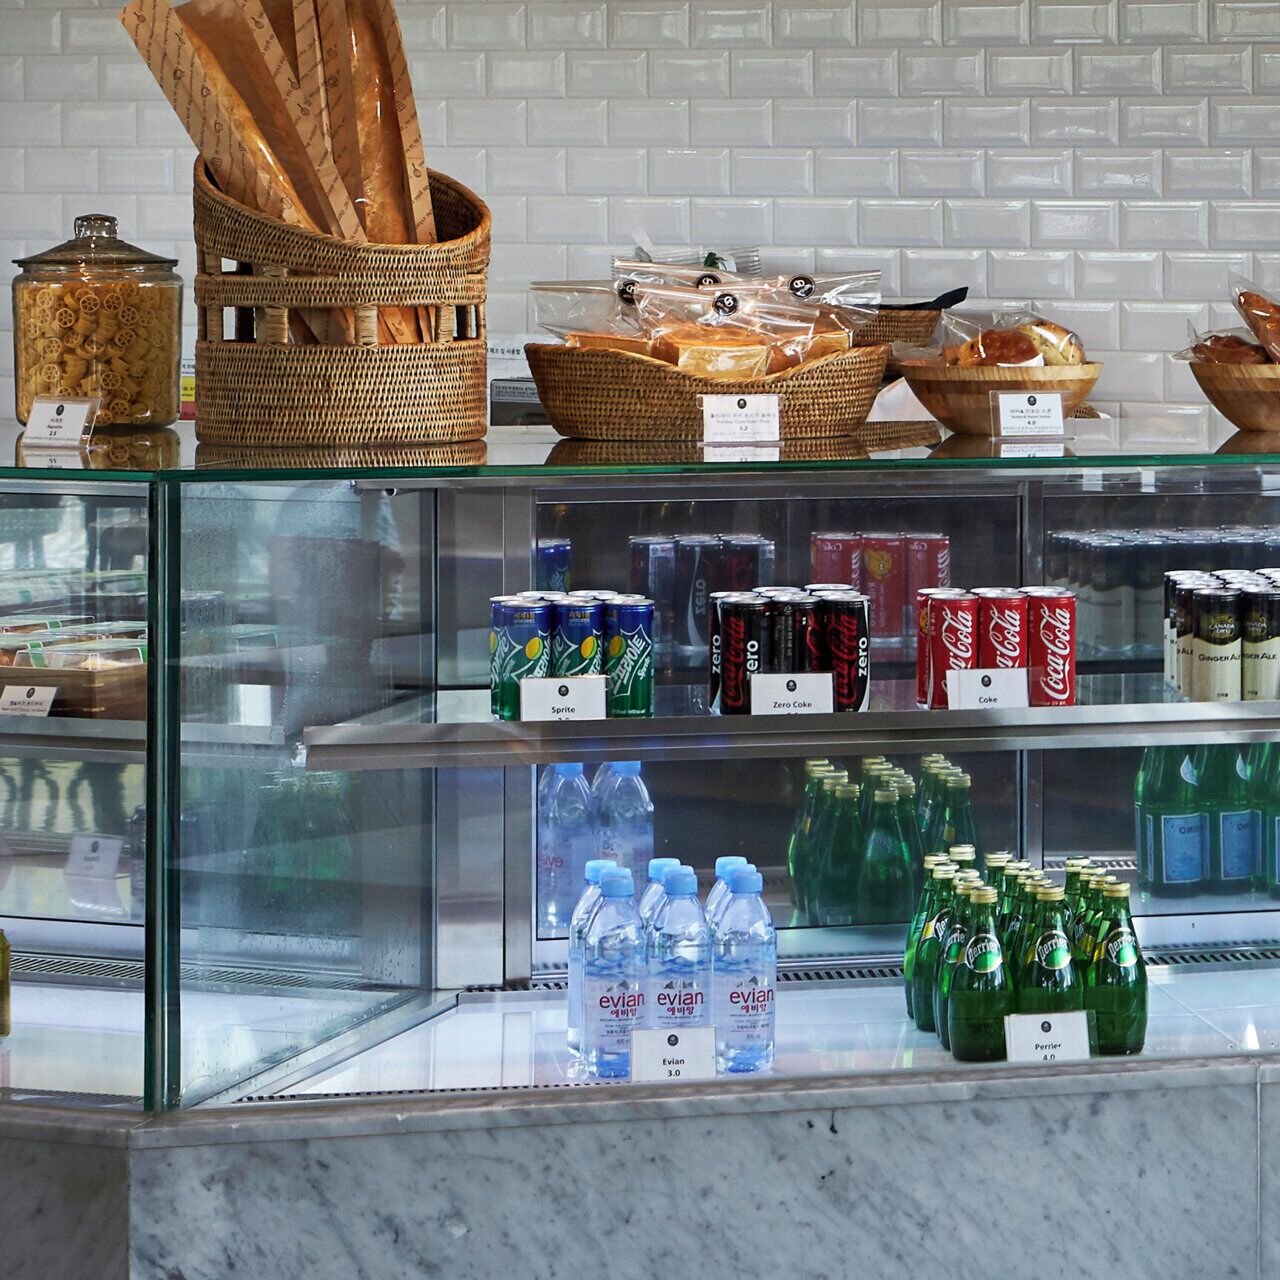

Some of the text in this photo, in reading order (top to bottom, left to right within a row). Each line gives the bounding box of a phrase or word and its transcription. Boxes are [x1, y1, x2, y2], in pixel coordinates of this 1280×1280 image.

[712, 634, 721, 674] zero
[858, 637, 868, 677] zero
[1199, 654, 1230, 663] GINGER
[978, 696, 998, 704] Coke
[773, 701, 812, 709] Zero Coke
[551, 706, 576, 715] Sprite
[966, 938, 1000, 963] Perrier
[1036, 935, 1069, 961] Perrier
[1107, 933, 1137, 960] Perrier
[599, 992, 645, 1009] evian
[657, 990, 704, 1006] evian
[729, 988, 775, 1004] evian
[610, 1008, 638, 1018] 에비앙
[666, 1006, 695, 1015] 에비앙
[740, 1004, 767, 1013] 에비앙
[1034, 1042, 1062, 1050] Perrier
[662, 1058, 685, 1066] Evian
[667, 1069, 681, 1077] 3.0
